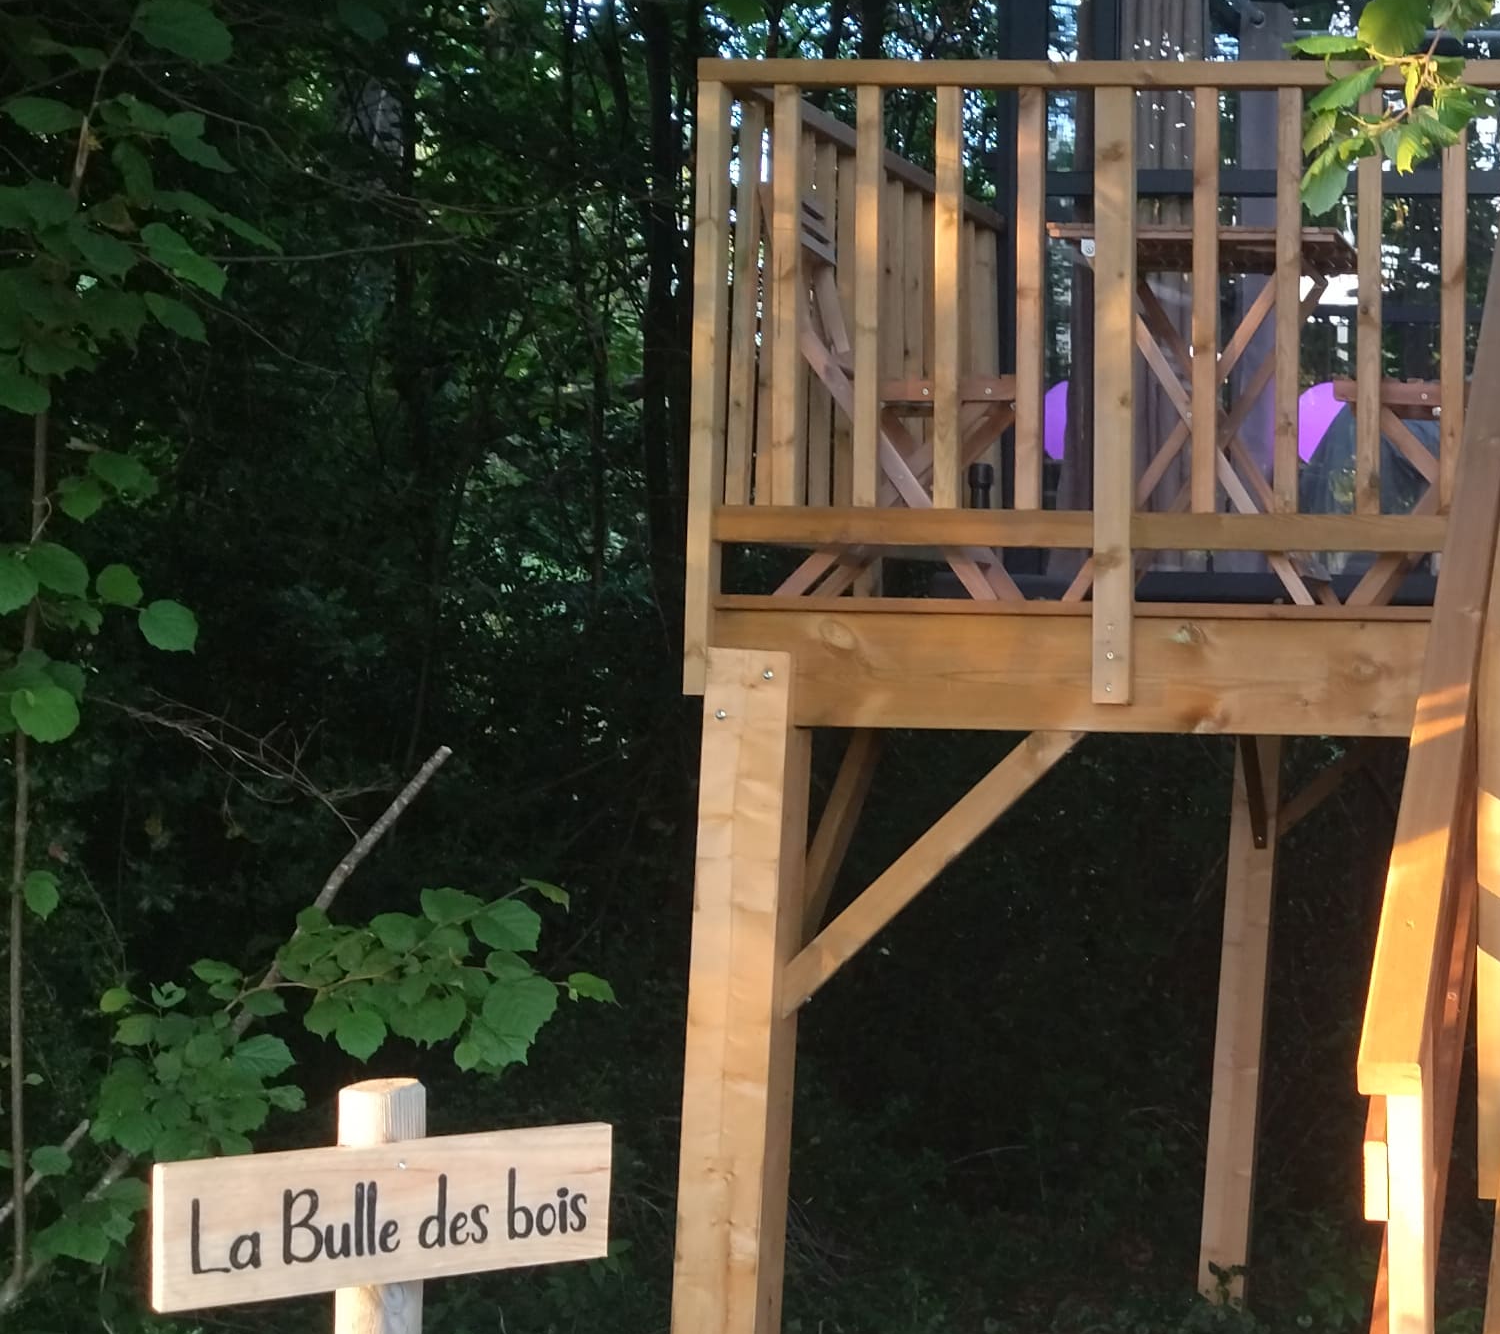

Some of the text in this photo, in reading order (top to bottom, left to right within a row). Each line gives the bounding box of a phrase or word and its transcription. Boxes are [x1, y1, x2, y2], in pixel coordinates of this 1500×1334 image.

[191, 1167, 587, 1274] La Bulle des bois
